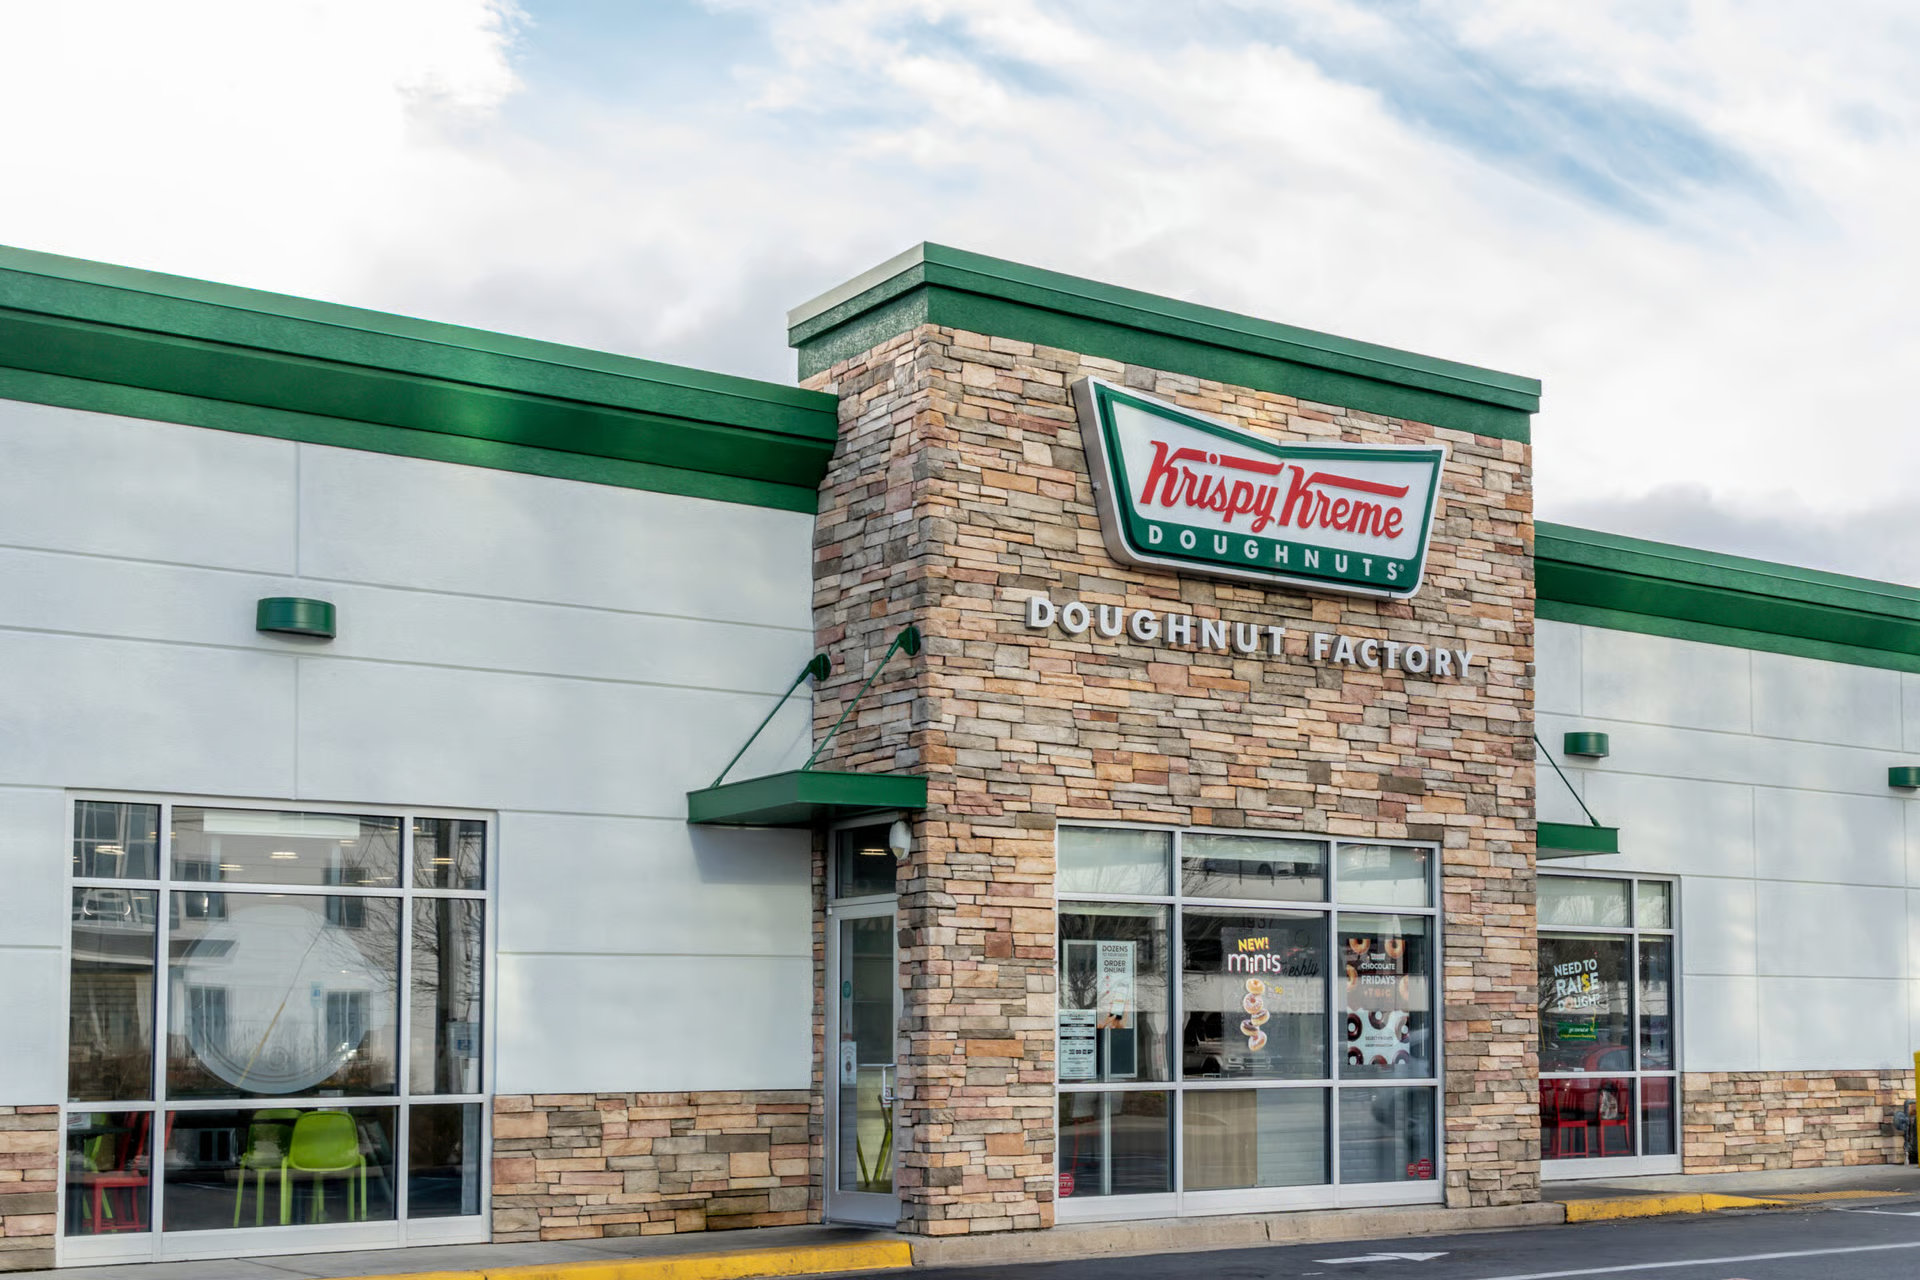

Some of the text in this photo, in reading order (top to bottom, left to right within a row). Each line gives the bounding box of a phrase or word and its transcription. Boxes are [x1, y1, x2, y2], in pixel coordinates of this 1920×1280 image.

[1140, 440, 1409, 539] Krispy Kreme
[1025, 596, 1474, 679] DOUGHNUT FACTORY
[1238, 936, 1270, 952] NEW!
[1228, 953, 1282, 975] minis
[1554, 958, 1597, 977] NEED TO
[1361, 975, 1396, 985] FRIDAYS
